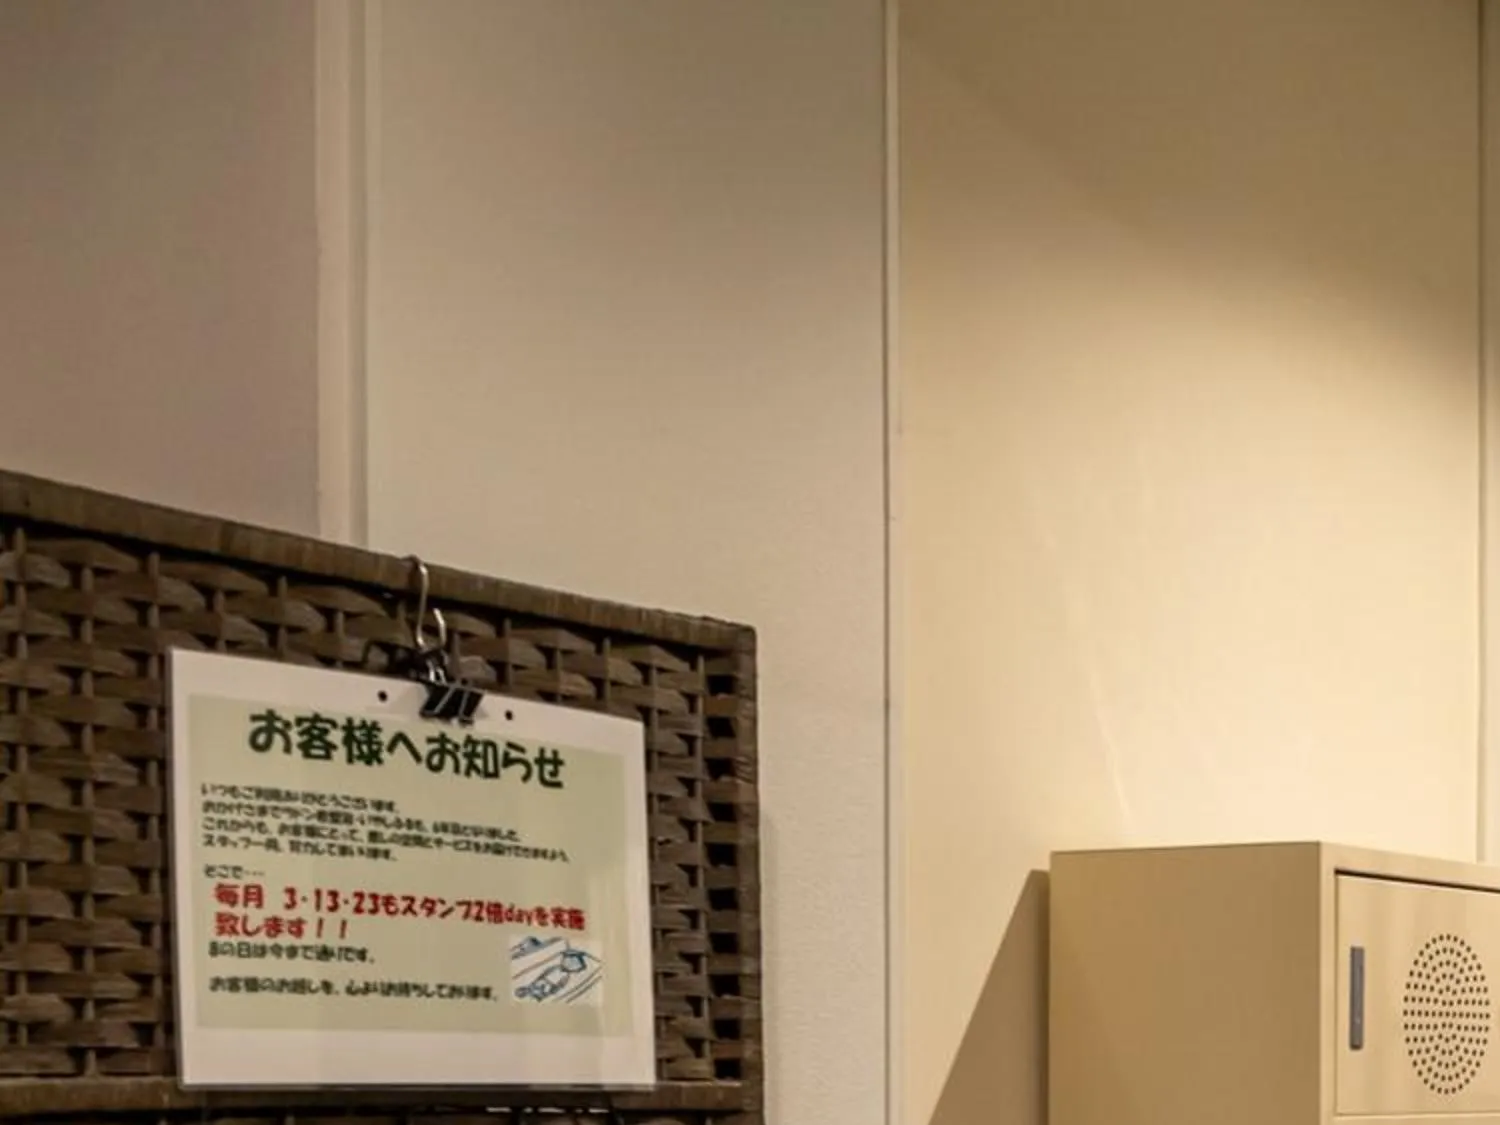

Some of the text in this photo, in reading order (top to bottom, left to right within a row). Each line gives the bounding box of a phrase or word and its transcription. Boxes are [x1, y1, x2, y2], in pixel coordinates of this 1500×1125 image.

[248, 709, 565, 788] お客様へお知らせ
[215, 883, 265, 908] 毎月
